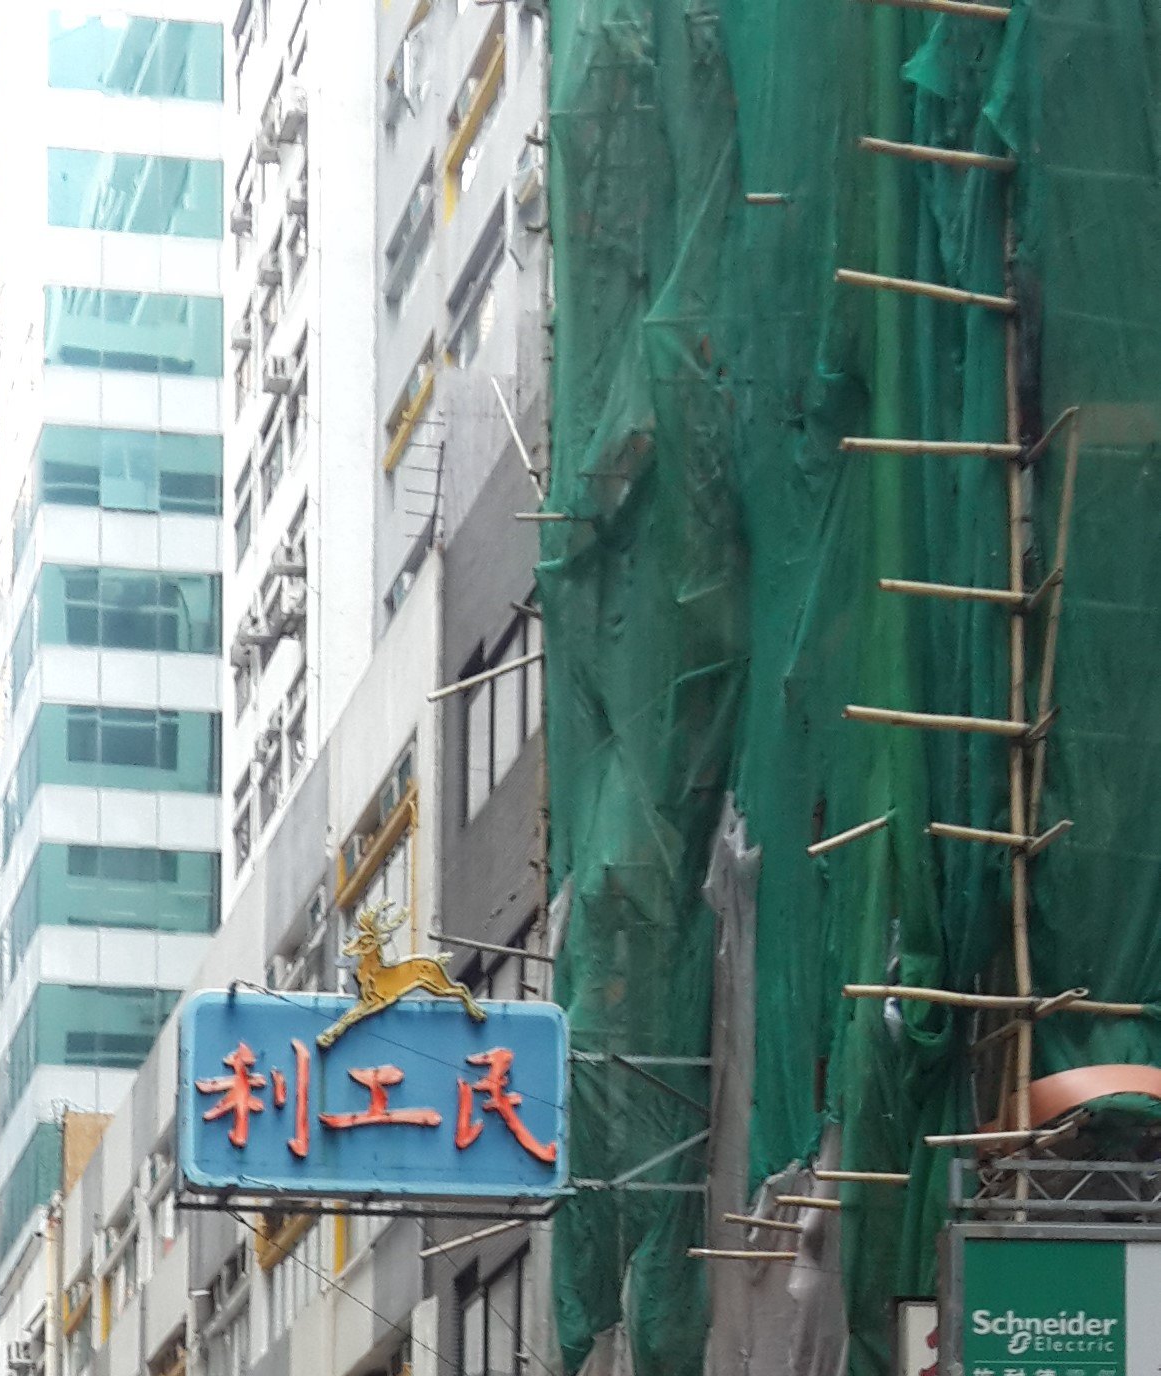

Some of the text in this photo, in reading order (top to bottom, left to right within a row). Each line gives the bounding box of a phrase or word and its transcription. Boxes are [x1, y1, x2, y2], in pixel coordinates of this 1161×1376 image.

[194, 1036, 558, 1163] 利工民
[972, 1309, 1118, 1336] Schneider
[1034, 1337, 1115, 1353] Electric
